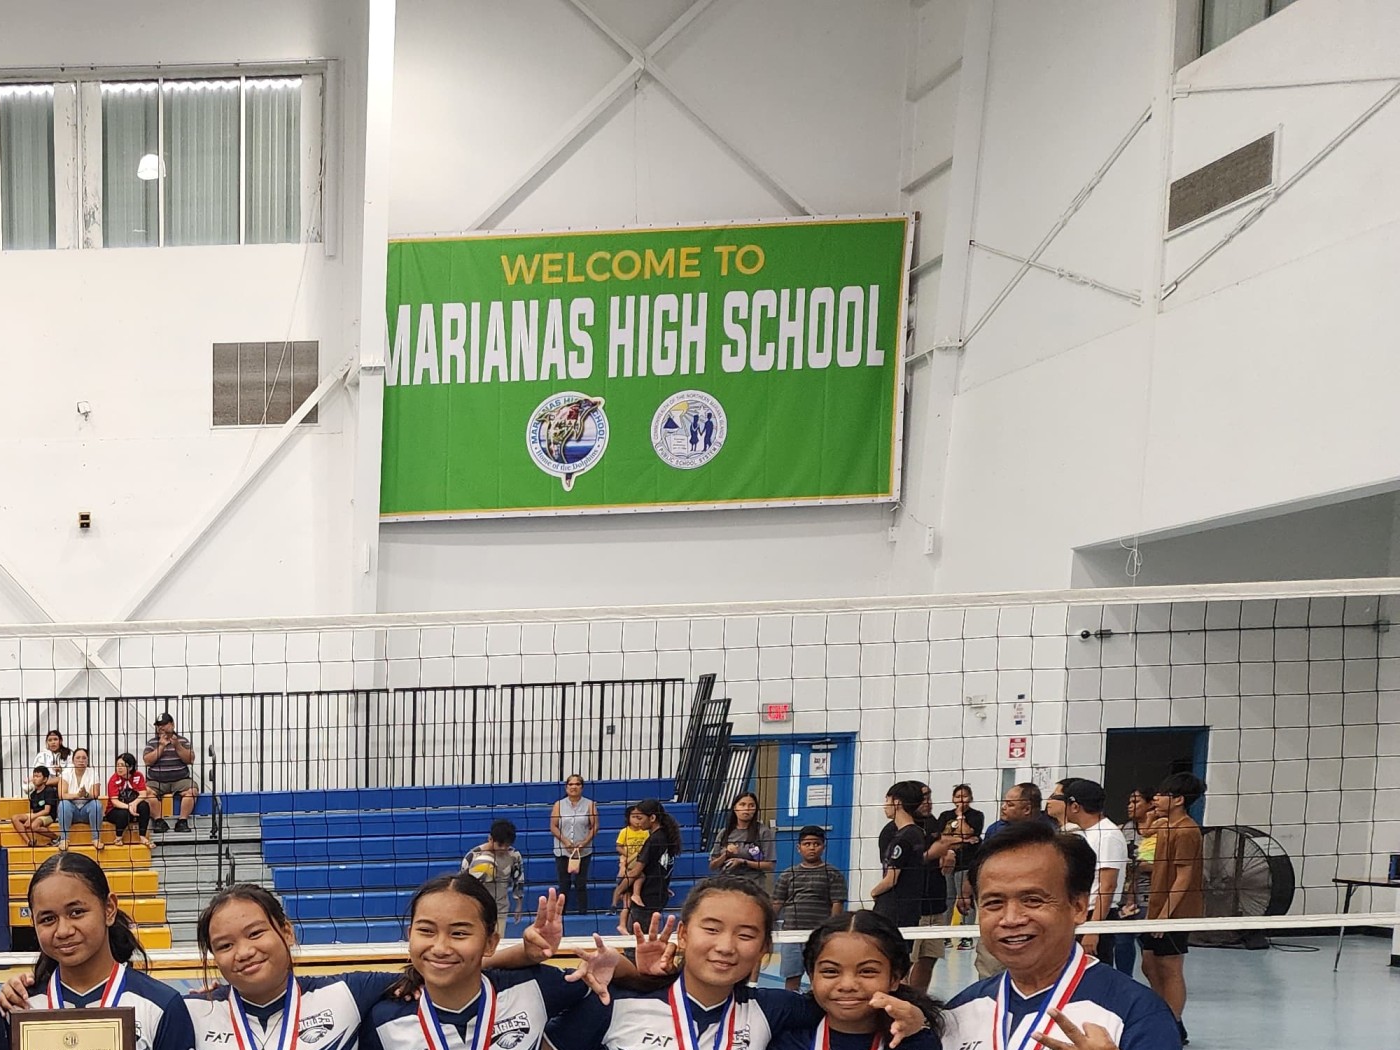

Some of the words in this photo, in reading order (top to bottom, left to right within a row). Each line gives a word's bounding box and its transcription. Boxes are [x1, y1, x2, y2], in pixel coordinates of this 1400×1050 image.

[500, 246, 701, 286] WELCOME
[714, 244, 765, 276] TO
[384, 296, 595, 387] MARIANAS
[607, 291, 708, 379] HIGH
[721, 283, 886, 374] SCHOOL
[204, 1031, 234, 1044] FAT
[641, 1033, 673, 1048] FAT
